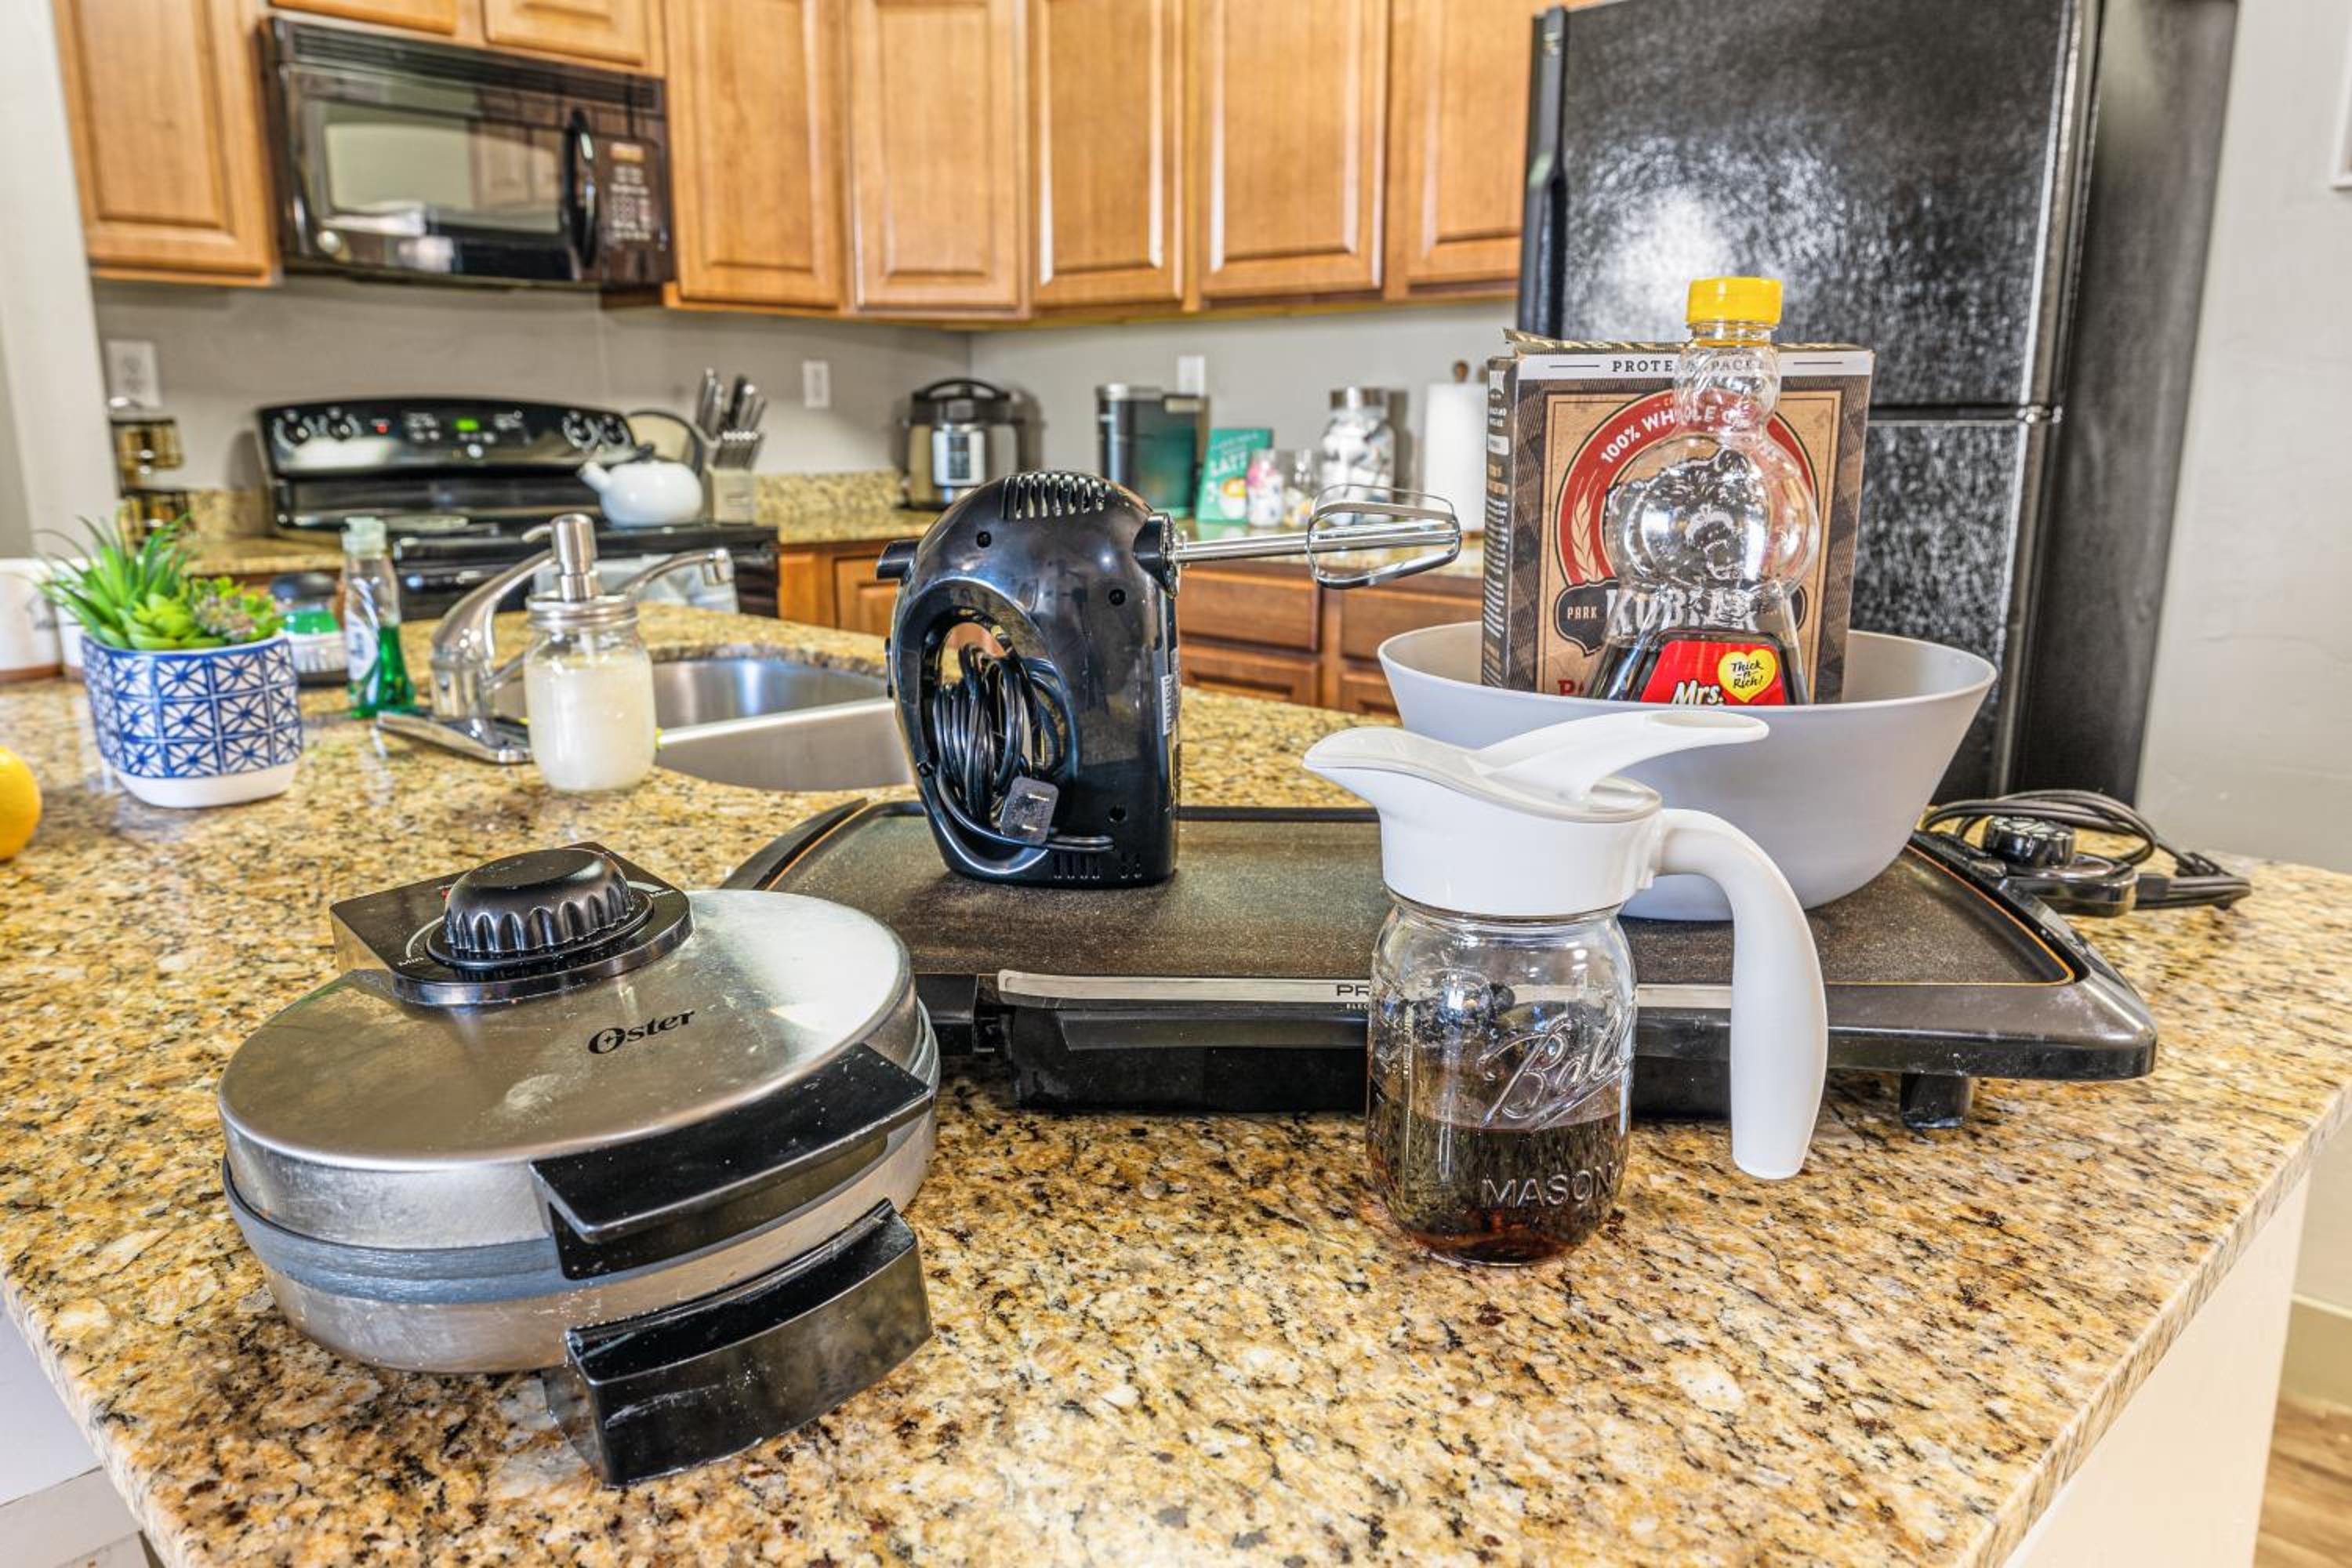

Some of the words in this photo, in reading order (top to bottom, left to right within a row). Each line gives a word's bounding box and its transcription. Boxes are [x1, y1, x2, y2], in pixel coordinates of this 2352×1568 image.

[1600, 417, 1641, 464] 100%
[1566, 607, 1599, 620] PARK
[1671, 681, 1726, 705] Mrs.
[588, 1009, 695, 1055] Oster
[1480, 1161, 1618, 1208] MASON
